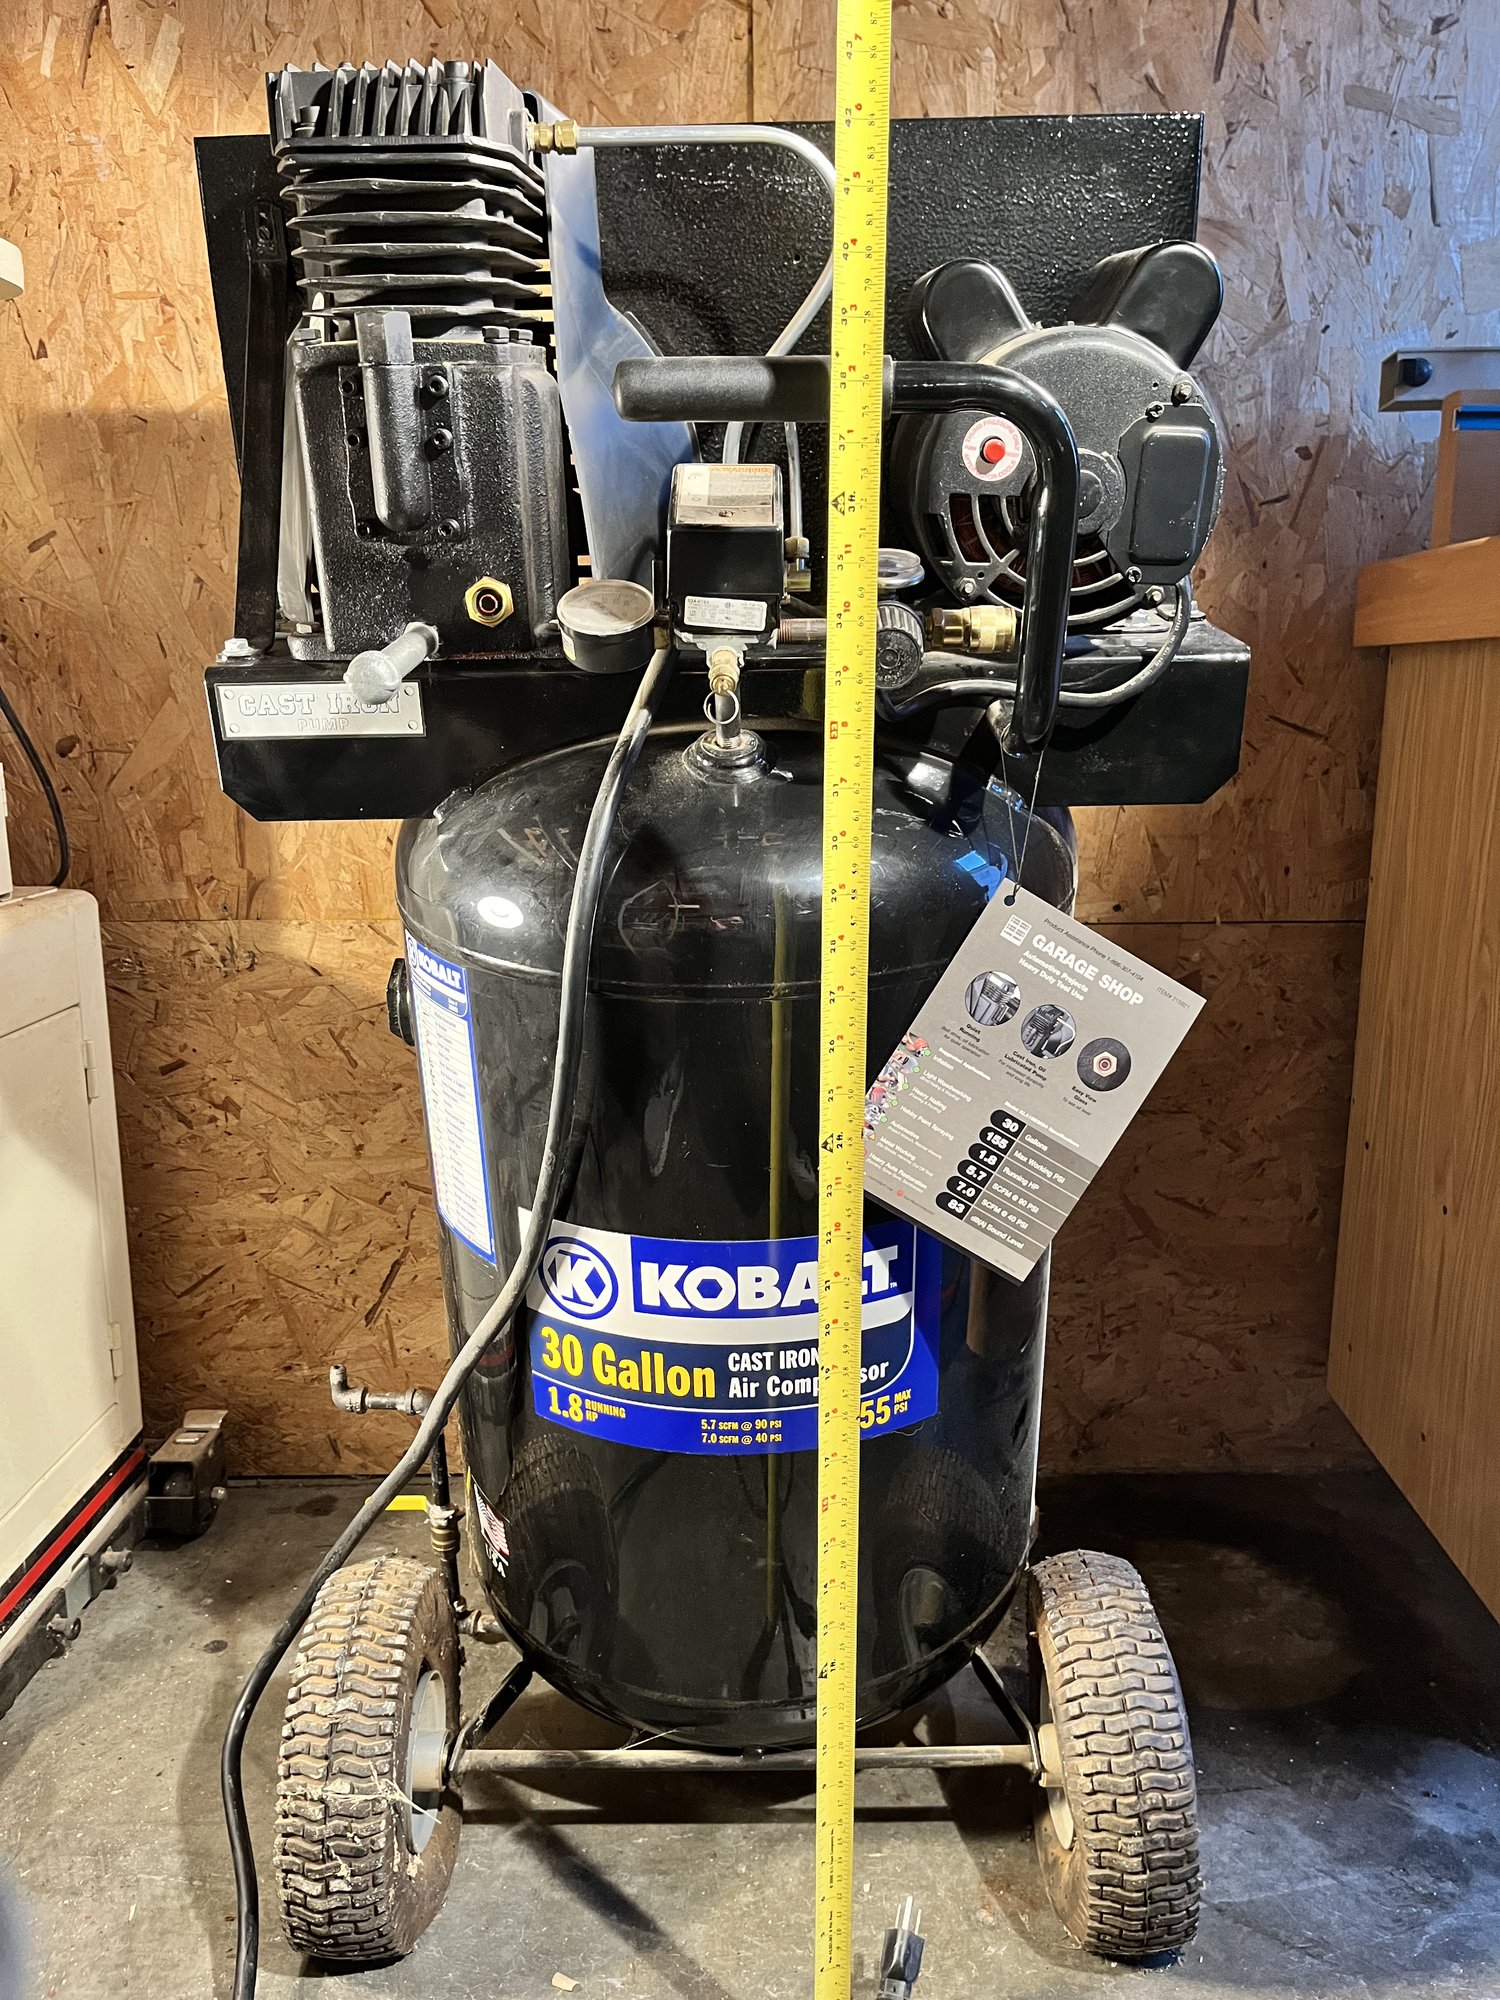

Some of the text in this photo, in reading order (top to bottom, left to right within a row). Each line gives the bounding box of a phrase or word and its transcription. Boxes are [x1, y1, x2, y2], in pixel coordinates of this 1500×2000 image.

[846, 40, 853, 60] 43
[845, 107, 852, 128] 42
[844, 177, 851, 195] 41
[843, 242, 849, 260] 40
[841, 307, 848, 326] 39
[840, 372, 847, 389] 38
[839, 434, 846, 451] 37
[848, 505, 856, 513] 3
[837, 554, 844, 571] 35
[836, 612, 843, 629] 34
[835, 670, 841, 687] 33
[238, 693, 315, 716] CAST
[297, 717, 350, 732] PUMP
[832, 783, 839, 797] 31
[832, 835, 838, 850] 30
[831, 888, 837, 903] 29
[830, 940, 836, 953] 28
[1043, 918, 1064, 932] Product
[1089, 946, 1105, 958] Phone
[417, 948, 462, 989] KOBALT
[1023, 950, 1088, 992] Automotive Projects
[1033, 934, 1143, 1004] GARAGE SHOP
[1018, 958, 1083, 1000] Heavy Duty Tool Use
[829, 990, 836, 1003] 27
[959, 1027, 980, 1042] Running
[966, 1023, 980, 1034] Quiet
[829, 1040, 835, 1053] 26
[933, 1055, 953, 1070] Inflation
[1012, 1051, 1025, 1060] Cast
[1004, 1053, 1046, 1080] Lubricated Pump
[923, 1070, 937, 1080] Light
[937, 1078, 971, 1102] Woodworking
[1071, 1086, 1096, 1102] Easy View
[827, 1088, 834, 1102] 25
[912, 1086, 928, 1099] Heavy
[928, 1096, 946, 1110] Nailing
[1073, 1095, 1087, 1105] Glass
[890, 1120, 919, 1139] Automotive
[900, 1105, 953, 1140] Hobby Paint Spraying
[1002, 1118, 1047, 1151] 30 Gallons
[879, 1136, 916, 1160] Metal Working
[986, 1132, 1065, 1183] 155 Max Working PSI
[869, 1152, 885, 1165] Heavy
[885, 1162, 898, 1172] Auto
[898, 1169, 926, 1189] Restoration
[979, 1150, 1039, 1189] 1.8 Running HP
[827, 1184, 833, 1197] 23
[965, 1165, 986, 1180] 5.7
[992, 1183, 1012, 1197] SCFM
[1017, 1198, 1027, 1206] 90
[1026, 1203, 1039, 1213] PSI
[956, 1181, 975, 1197] 7.0
[981, 1199, 1001, 1213] SCFM
[1007, 1214, 1016, 1222] 40
[1015, 1218, 1028, 1229] PSI
[947, 1199, 964, 1213] 83
[970, 1216, 986, 1228] dB(A)
[986, 1224, 1007, 1239] Sound
[1006, 1235, 1024, 1248] Level
[825, 1231, 831, 1244] 22
[640, 1245, 898, 1312] KOBAT
[825, 1279, 831, 1291] 21
[825, 1323, 830, 1336] 20
[540, 1326, 716, 1398] 30 Gallon
[727, 1351, 774, 1372] CAST
[728, 1359, 889, 1398] Air Compsor
[825, 1368, 830, 1380] 19
[548, 1386, 626, 1422] 1.8 RUNNING HP
[860, 1388, 912, 1429] 55 MAX PSI
[701, 1418, 782, 1431] 5.7 SCFM @ 90 PSI
[825, 1412, 830, 1424] 18
[701, 1432, 782, 1445] 7.0 SCFM @ 40 PSI
[824, 1457, 829, 1468] 17
[823, 1542, 829, 1553] 15
[485, 1542, 507, 1578] USA
[823, 1583, 829, 1594] 14
[823, 1624, 828, 1636] 13
